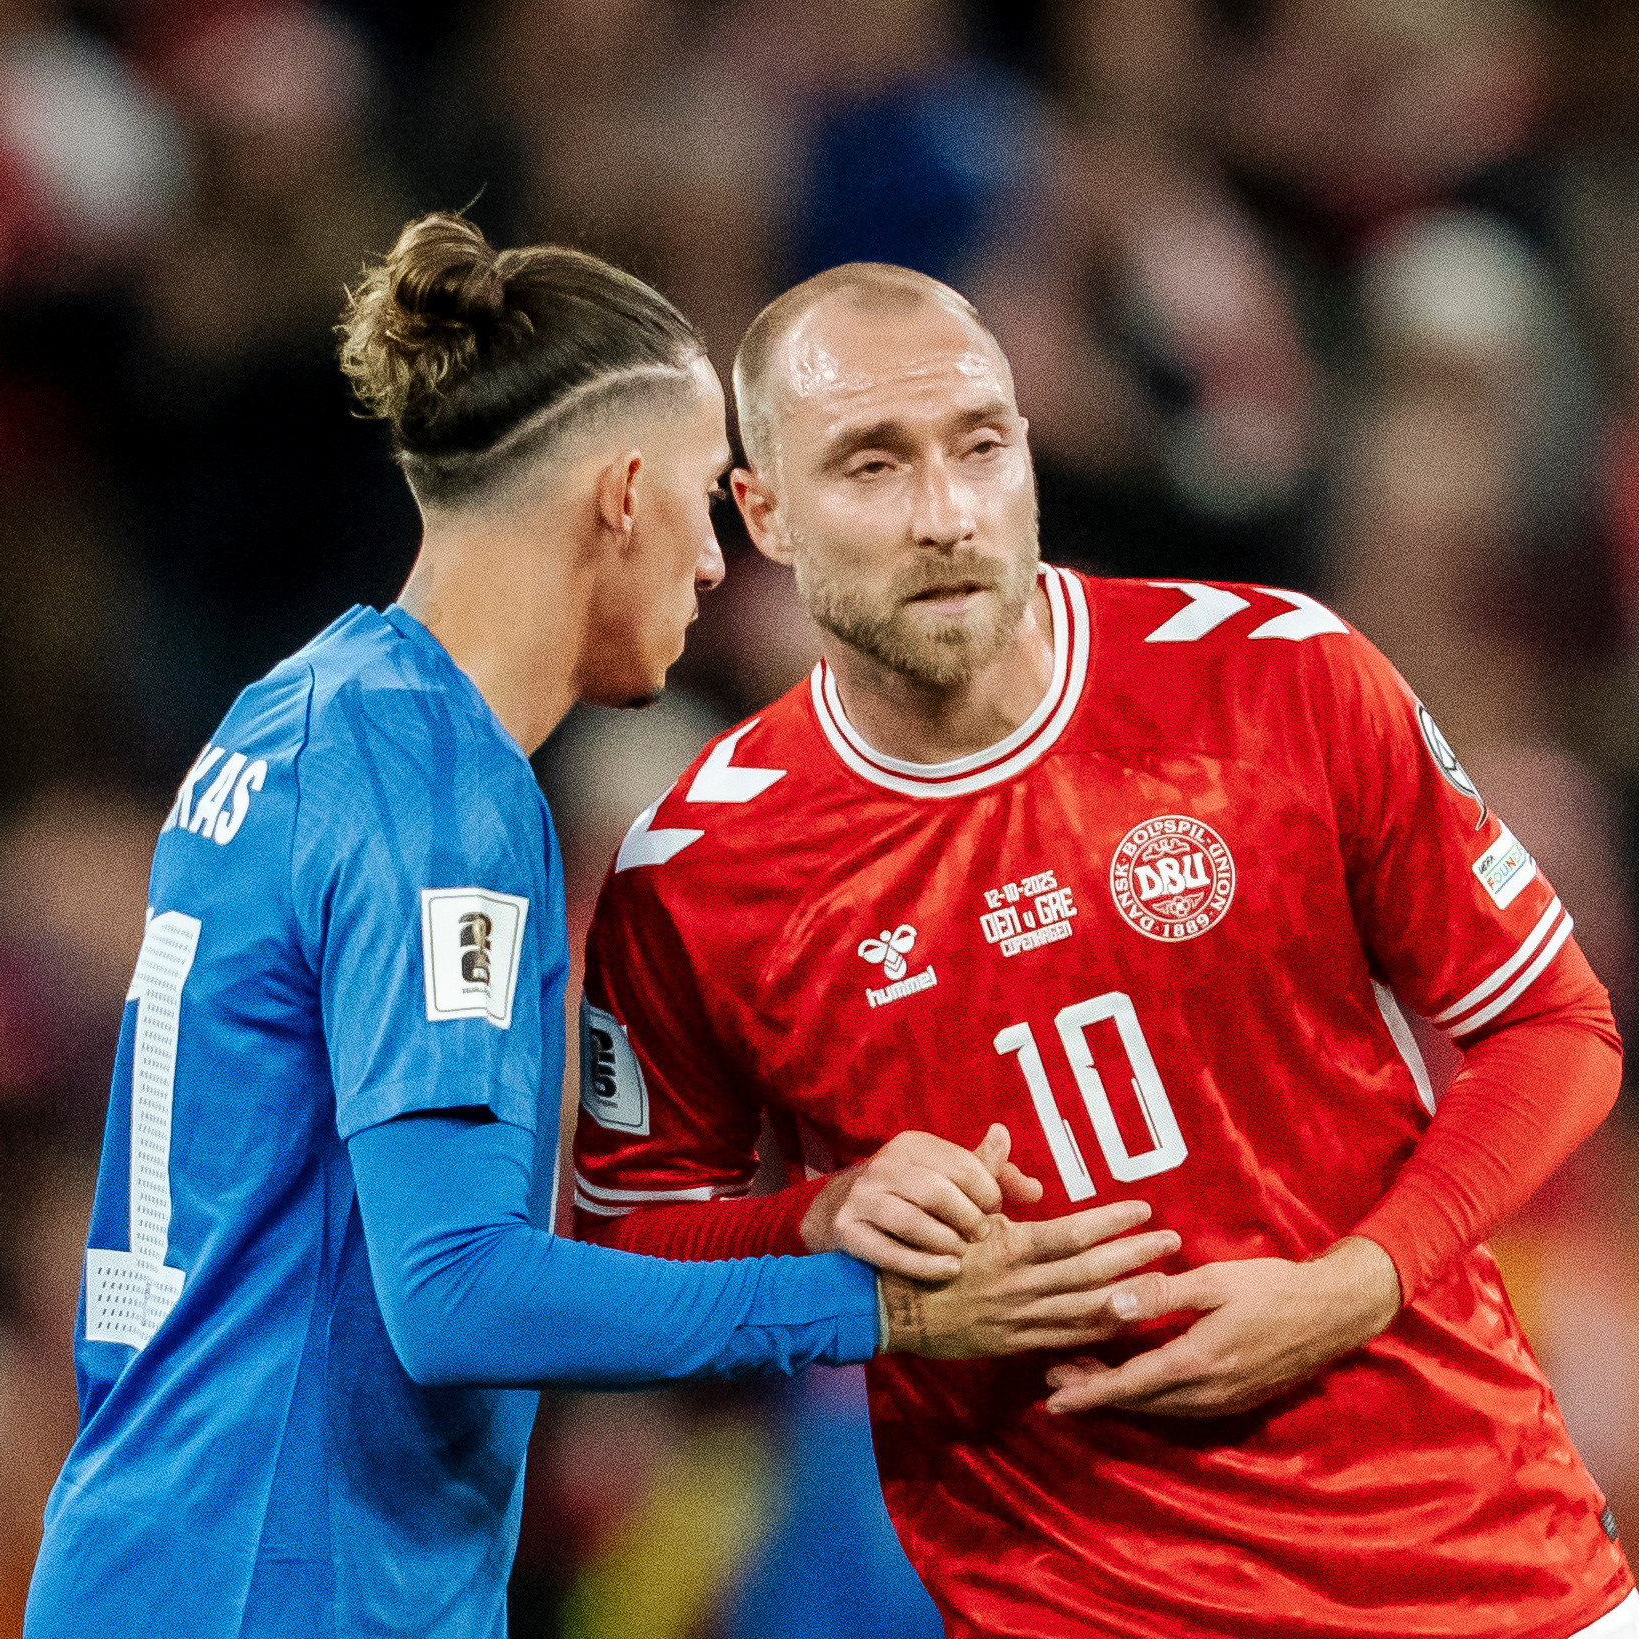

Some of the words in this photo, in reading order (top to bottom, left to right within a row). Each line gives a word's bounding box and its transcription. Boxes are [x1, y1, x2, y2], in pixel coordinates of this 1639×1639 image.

[1114, 862, 1156, 932] DANSK
[1207, 842, 1232, 911] UNION
[1133, 851, 1211, 902] DBU
[979, 905, 1023, 944] DEN
[1034, 886, 1078, 926] GRE
[865, 964, 938, 1009] hummel
[992, 990, 1189, 1203] 10
